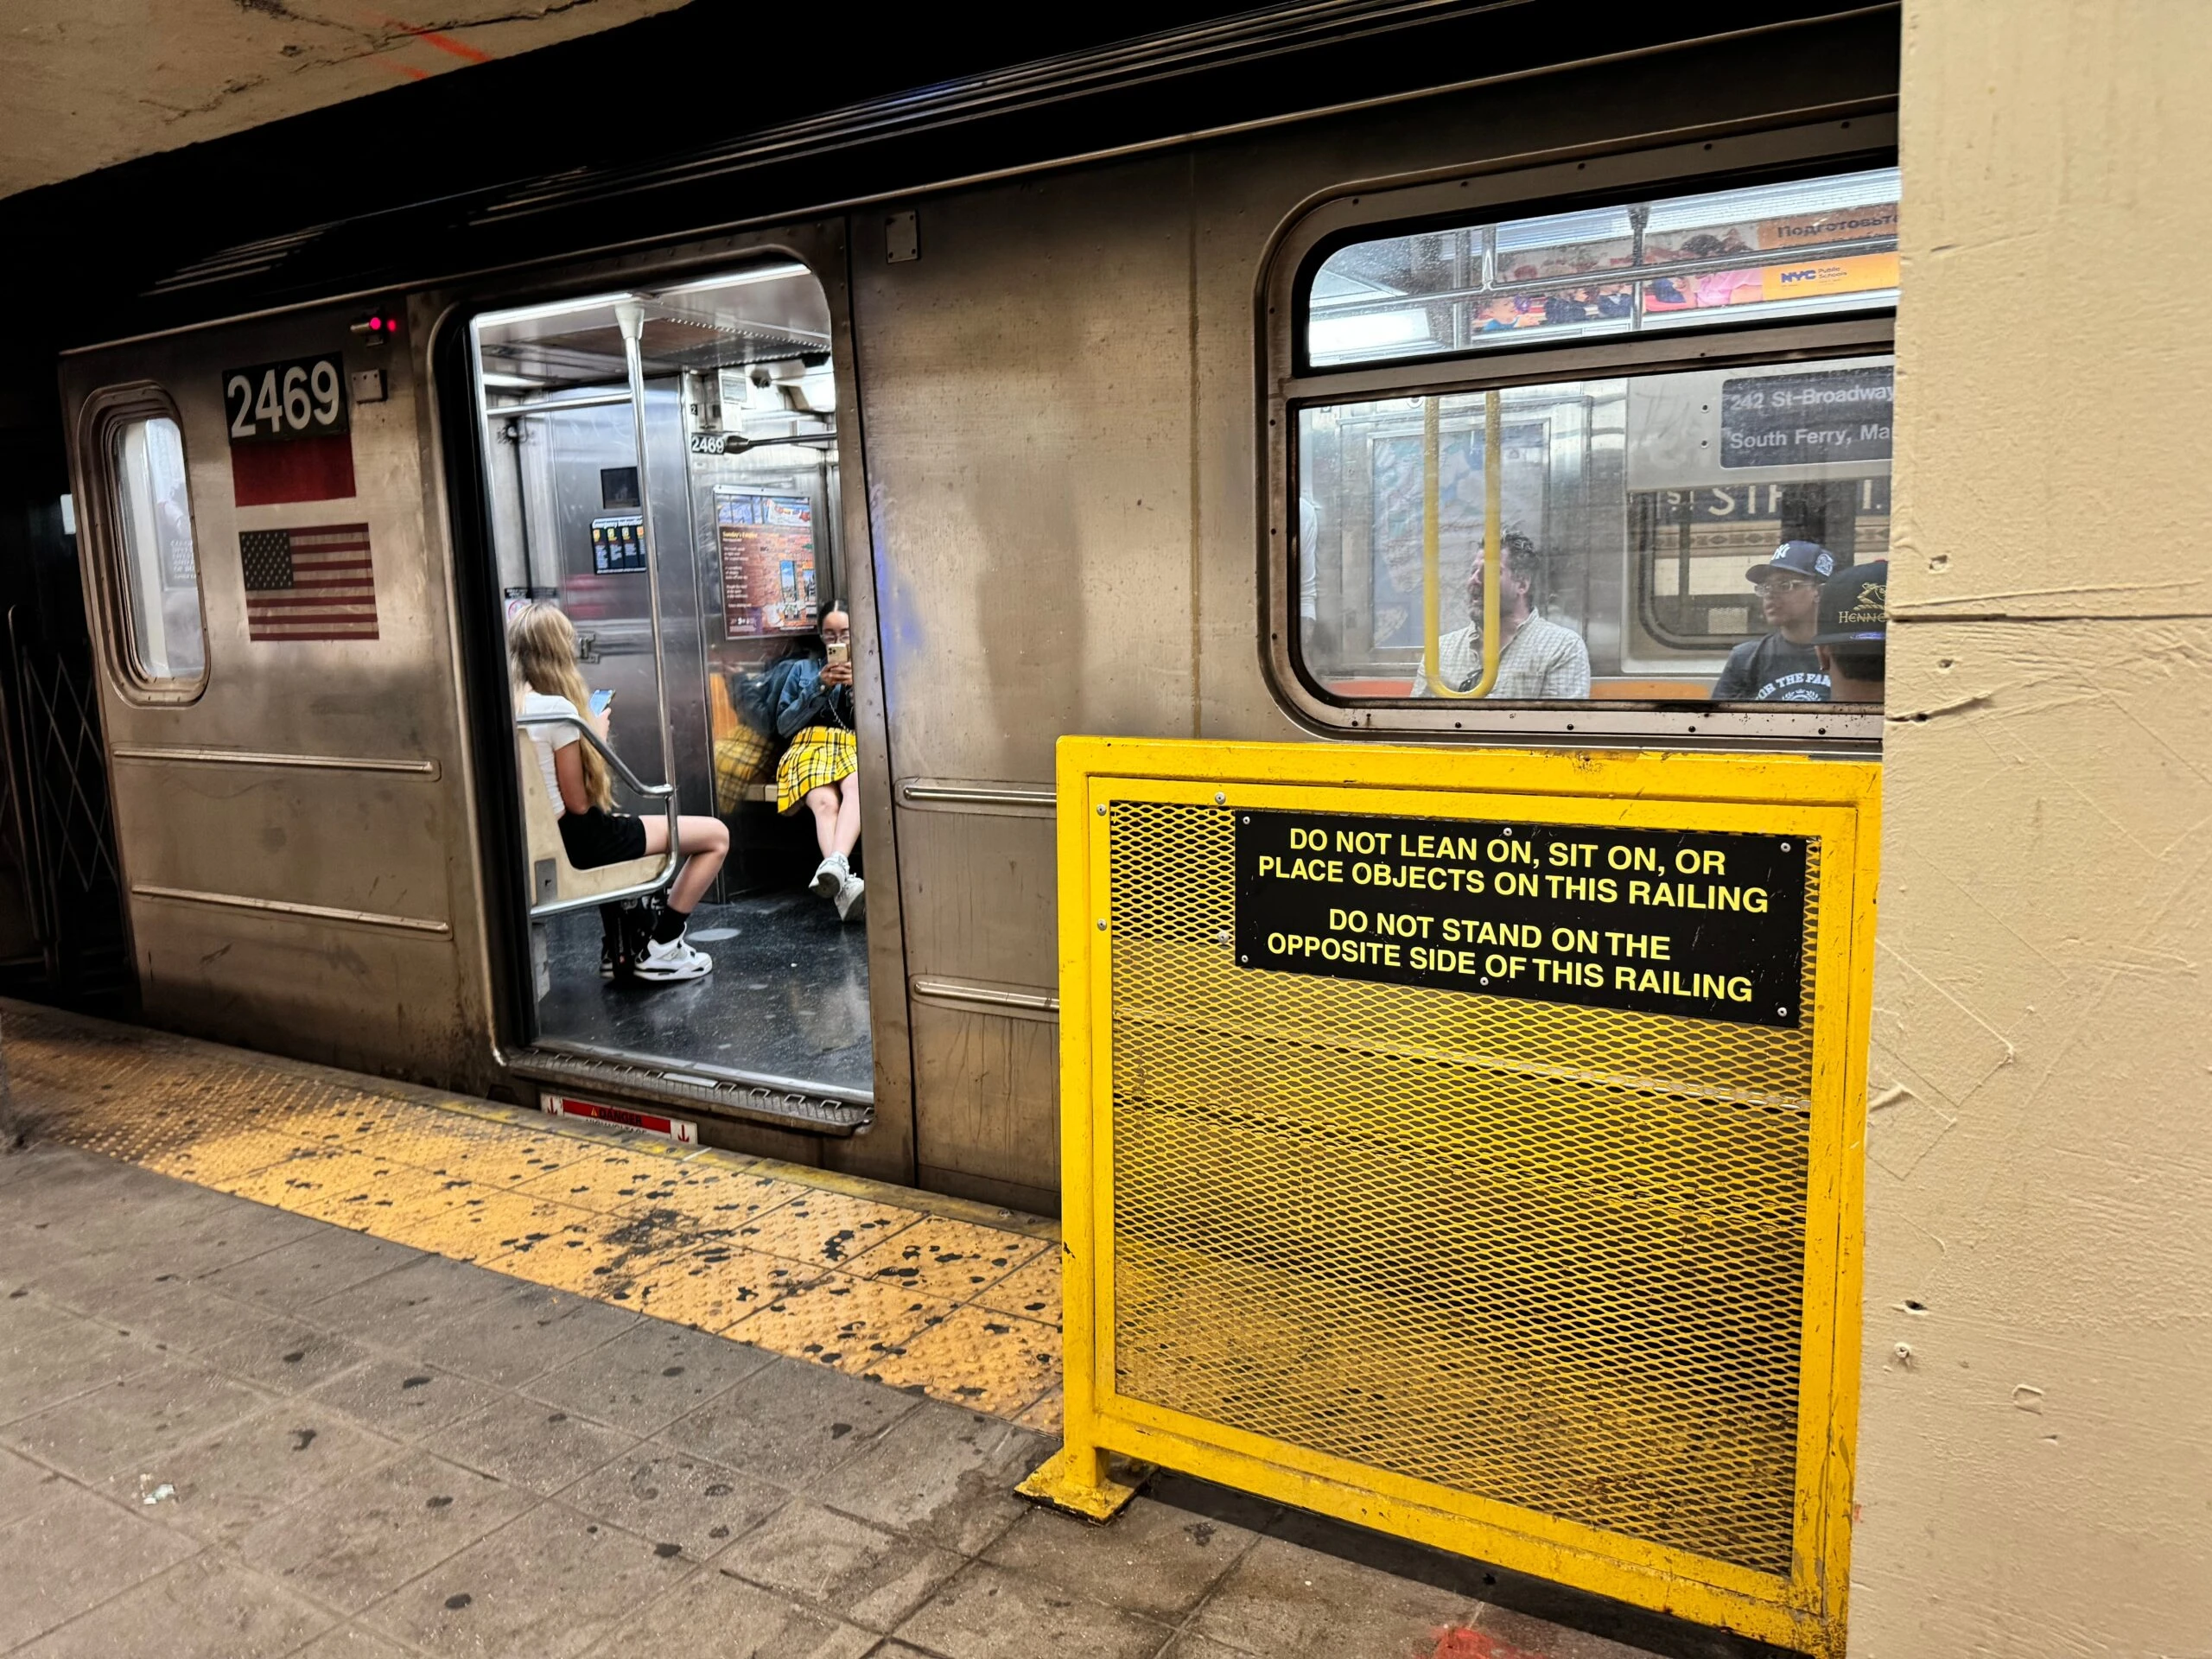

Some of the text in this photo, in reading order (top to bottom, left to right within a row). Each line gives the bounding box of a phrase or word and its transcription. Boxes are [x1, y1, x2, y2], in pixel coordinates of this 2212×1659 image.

[1780, 269, 1817, 283] NYC
[227, 359, 340, 439] 2469
[1731, 391, 1765, 410] 242
[691, 435, 725, 454] 2469
[1731, 432, 1787, 449] South
[1795, 428, 1852, 446] Ferry,
[1775, 673, 1804, 689] THE
[1290, 828, 1726, 877] DO NOT LEAN ON, SIT ON, OR
[1258, 855, 1769, 913] PLACE OBJECTS ON THIS RAILING
[1329, 908, 1671, 961] DO NOT STAND ON THE
[1267, 932, 1753, 1002] OPPOSITE SIDE OF THIS RAILING
[599, 1108, 642, 1127] DANGER
